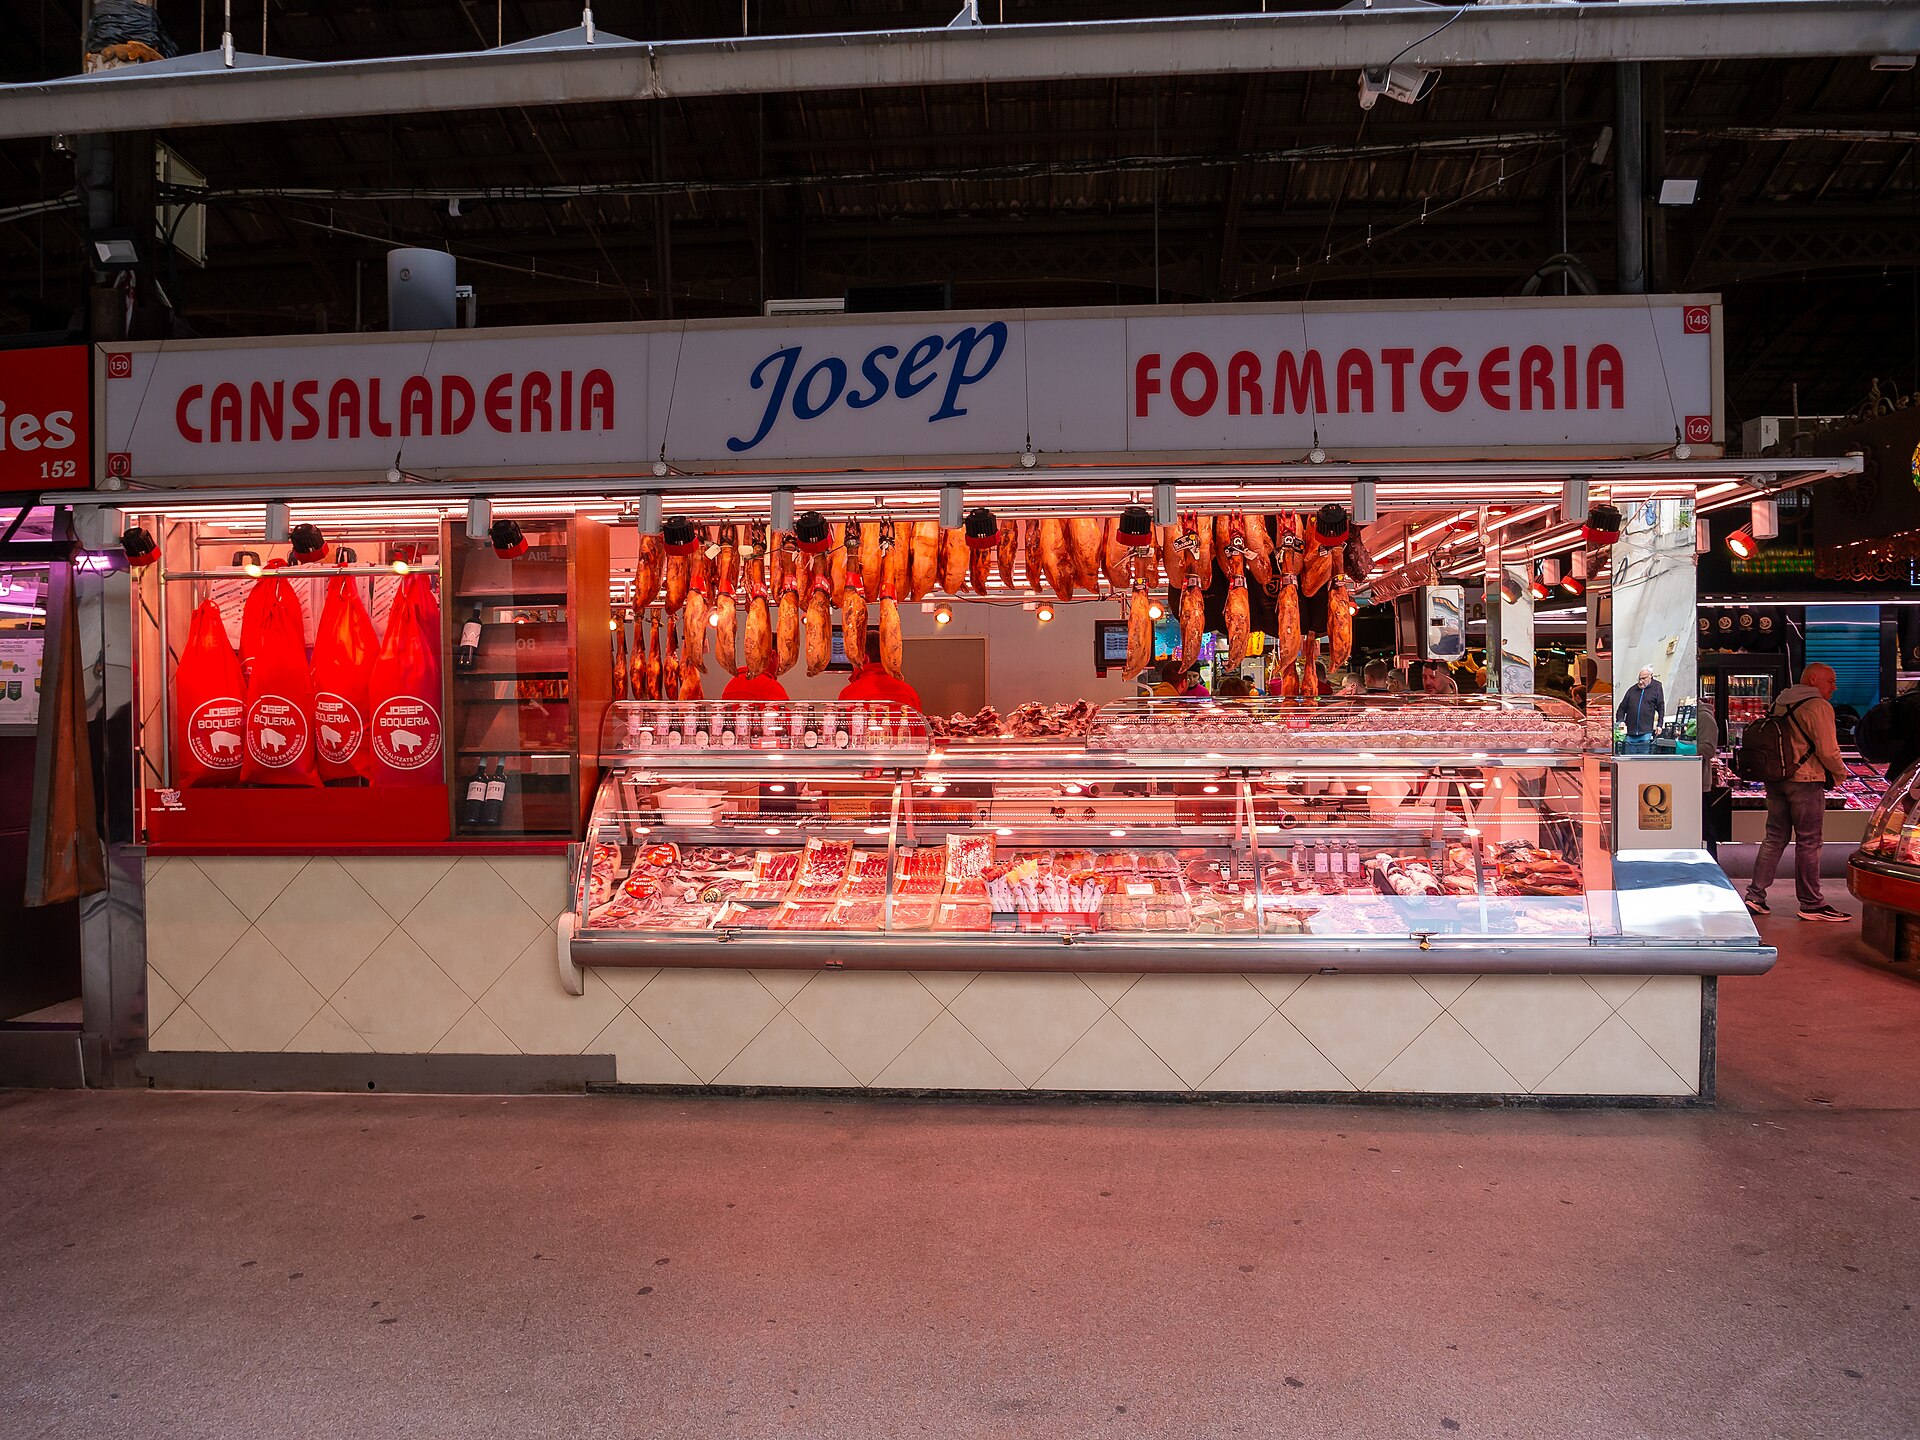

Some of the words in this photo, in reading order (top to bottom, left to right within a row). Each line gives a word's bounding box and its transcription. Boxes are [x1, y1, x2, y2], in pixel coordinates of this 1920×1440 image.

[1688, 315, 1709, 325] 148
[111, 361, 128, 370] 150
[1135, 343, 1625, 417] FORMATGERIA
[726, 321, 1009, 452] Josep
[176, 368, 615, 444] CANSALADERIA
[1690, 424, 1710, 435] 149
[40, 460, 77, 479] 152
[203, 706, 243, 718] JOSEP
[260, 704, 290, 715] OSEP
[385, 705, 424, 715] JOSEP
[379, 717, 430, 729] BOQUERIA
[377, 735, 414, 763] ESPECIALITZATS
[1643, 784, 1668, 813] Q
